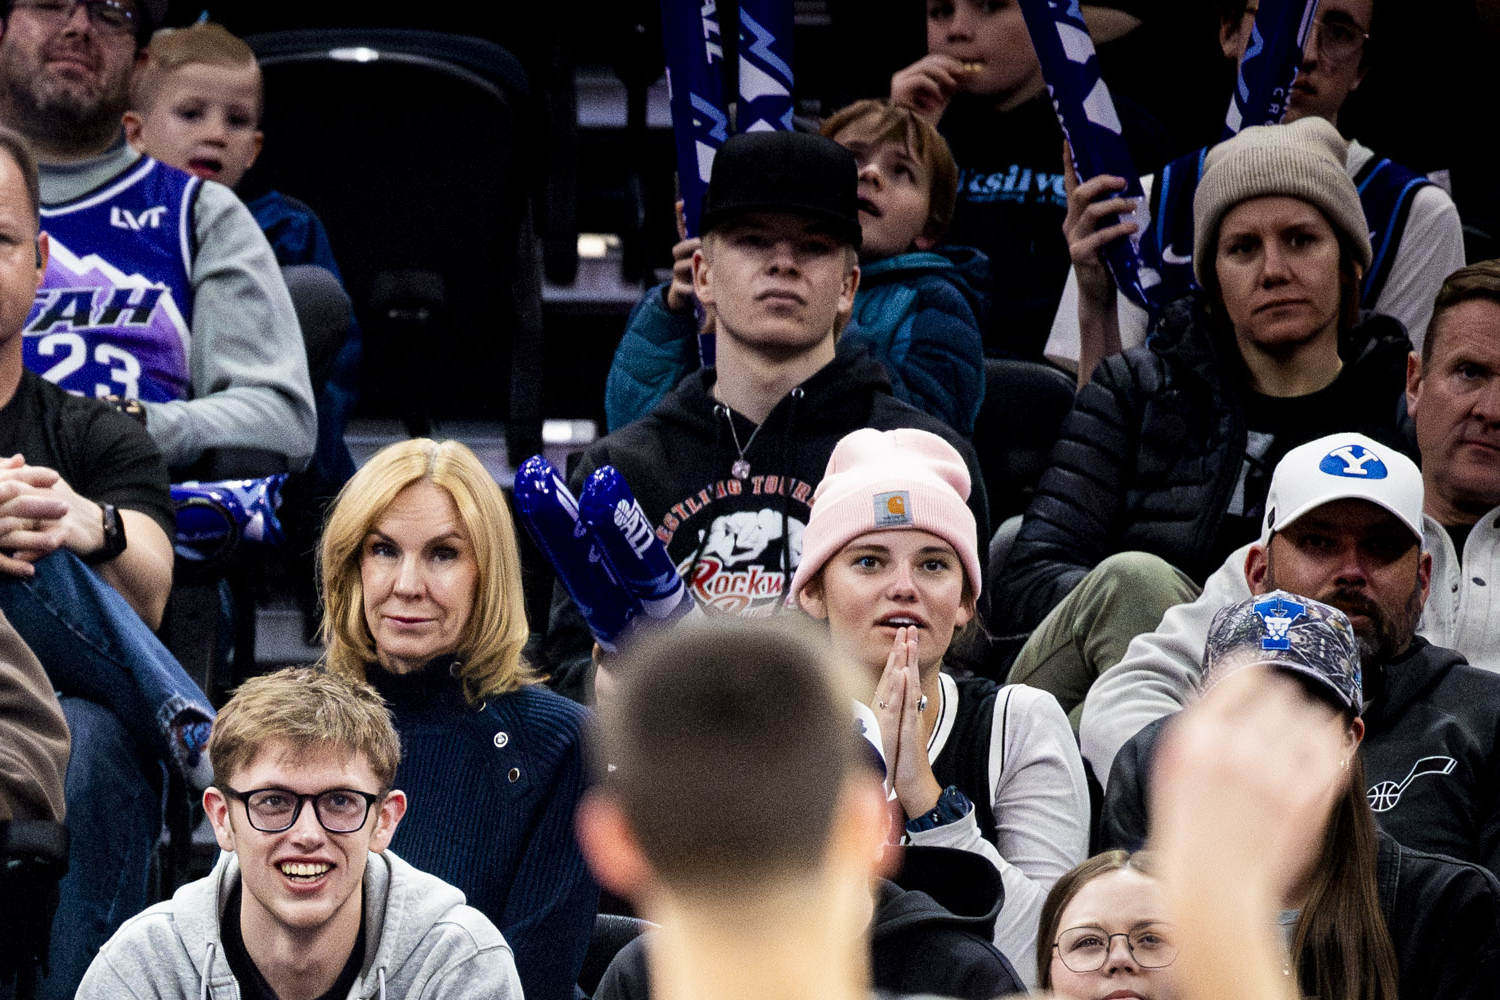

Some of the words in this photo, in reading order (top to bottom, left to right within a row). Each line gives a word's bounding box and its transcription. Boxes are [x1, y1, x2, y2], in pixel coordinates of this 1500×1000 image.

[110, 205, 168, 231] LVT
[38, 332, 141, 400] 23
[1330, 446, 1379, 475] Y
